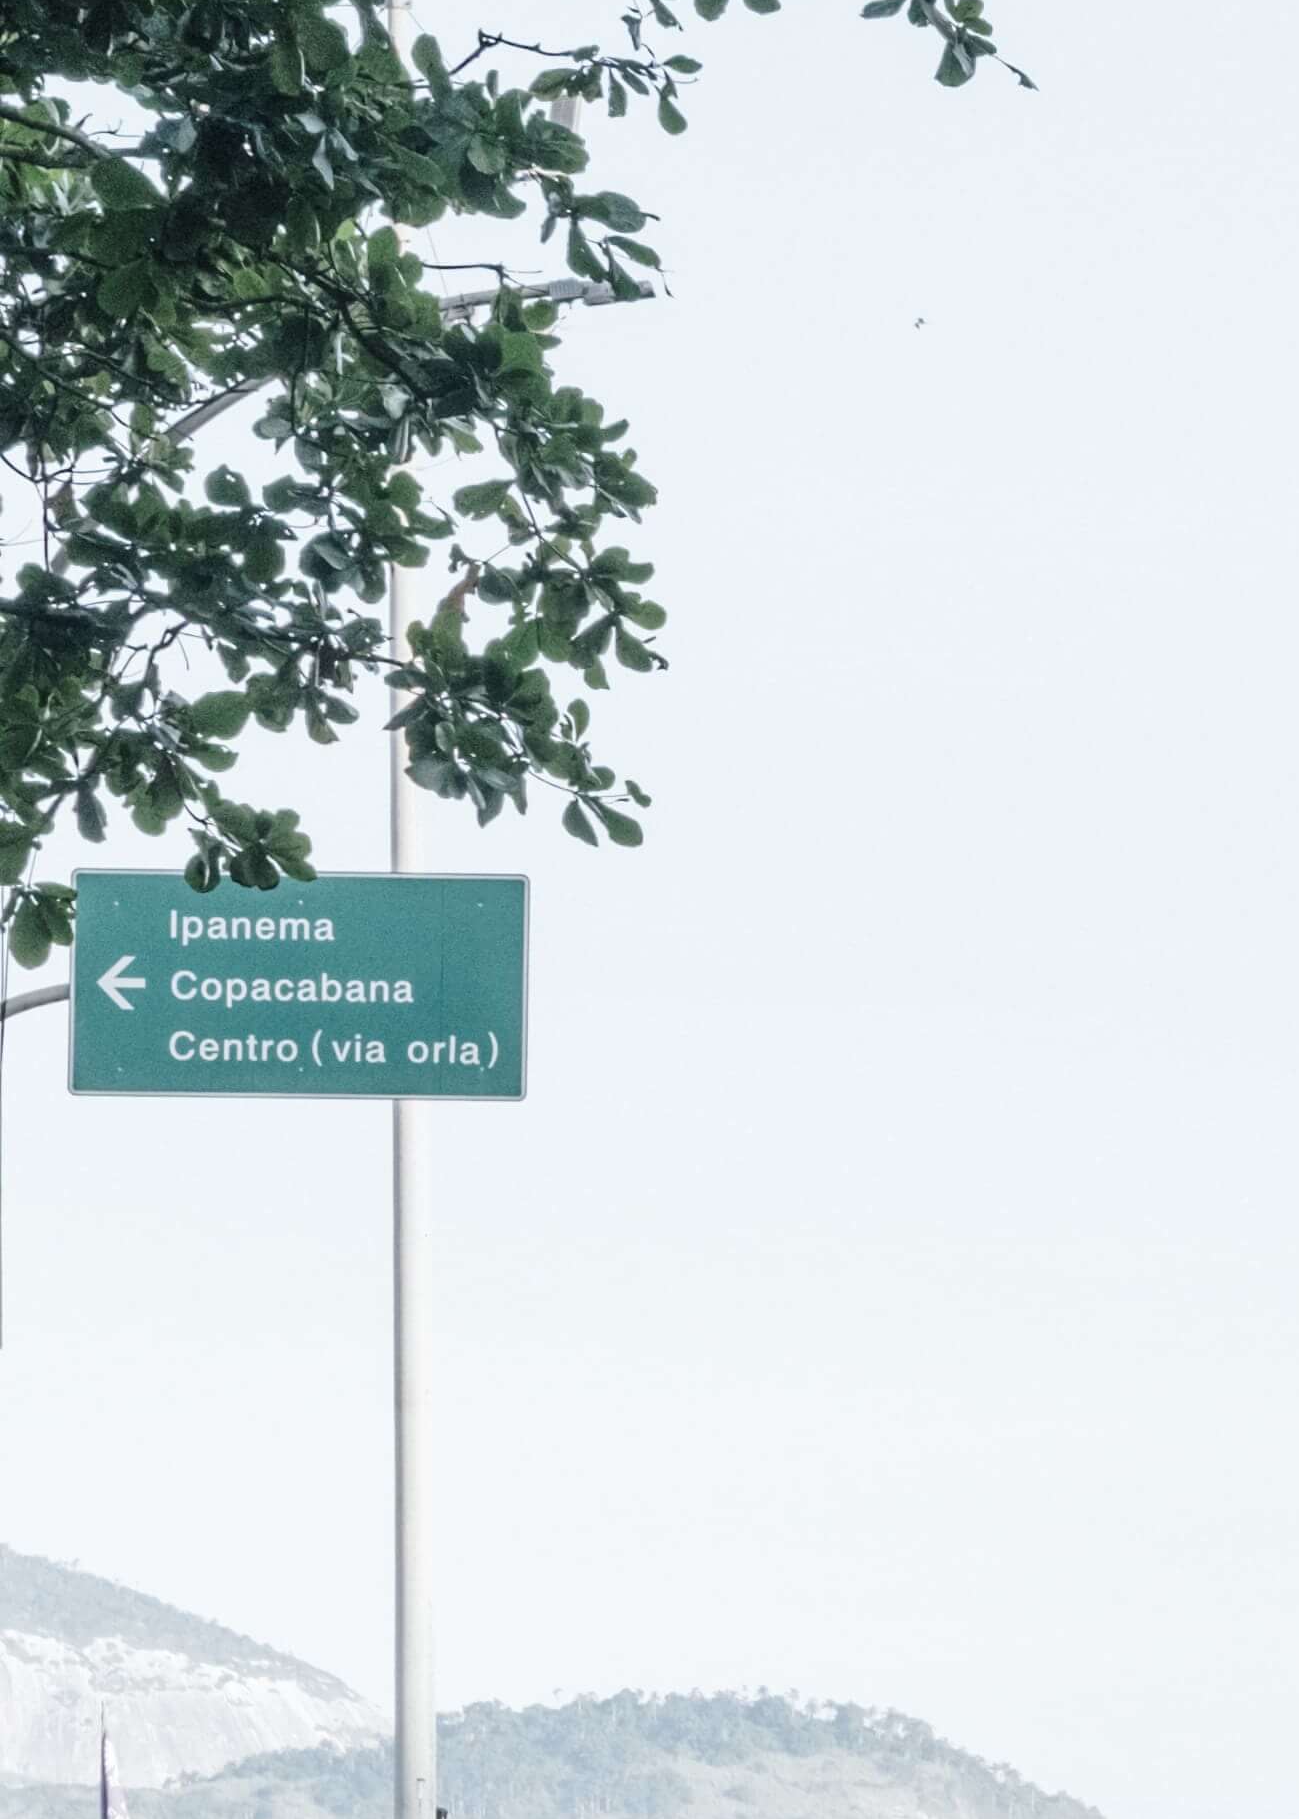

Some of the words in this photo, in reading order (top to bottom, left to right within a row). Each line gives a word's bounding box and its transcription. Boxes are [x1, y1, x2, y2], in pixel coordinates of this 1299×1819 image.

[169, 909, 335, 946] Ipanema
[170, 970, 414, 1008] Copacabana
[168, 1030, 298, 1062] Centro
[312, 1029, 387, 1067] (via
[407, 1031, 499, 1069] orla)
